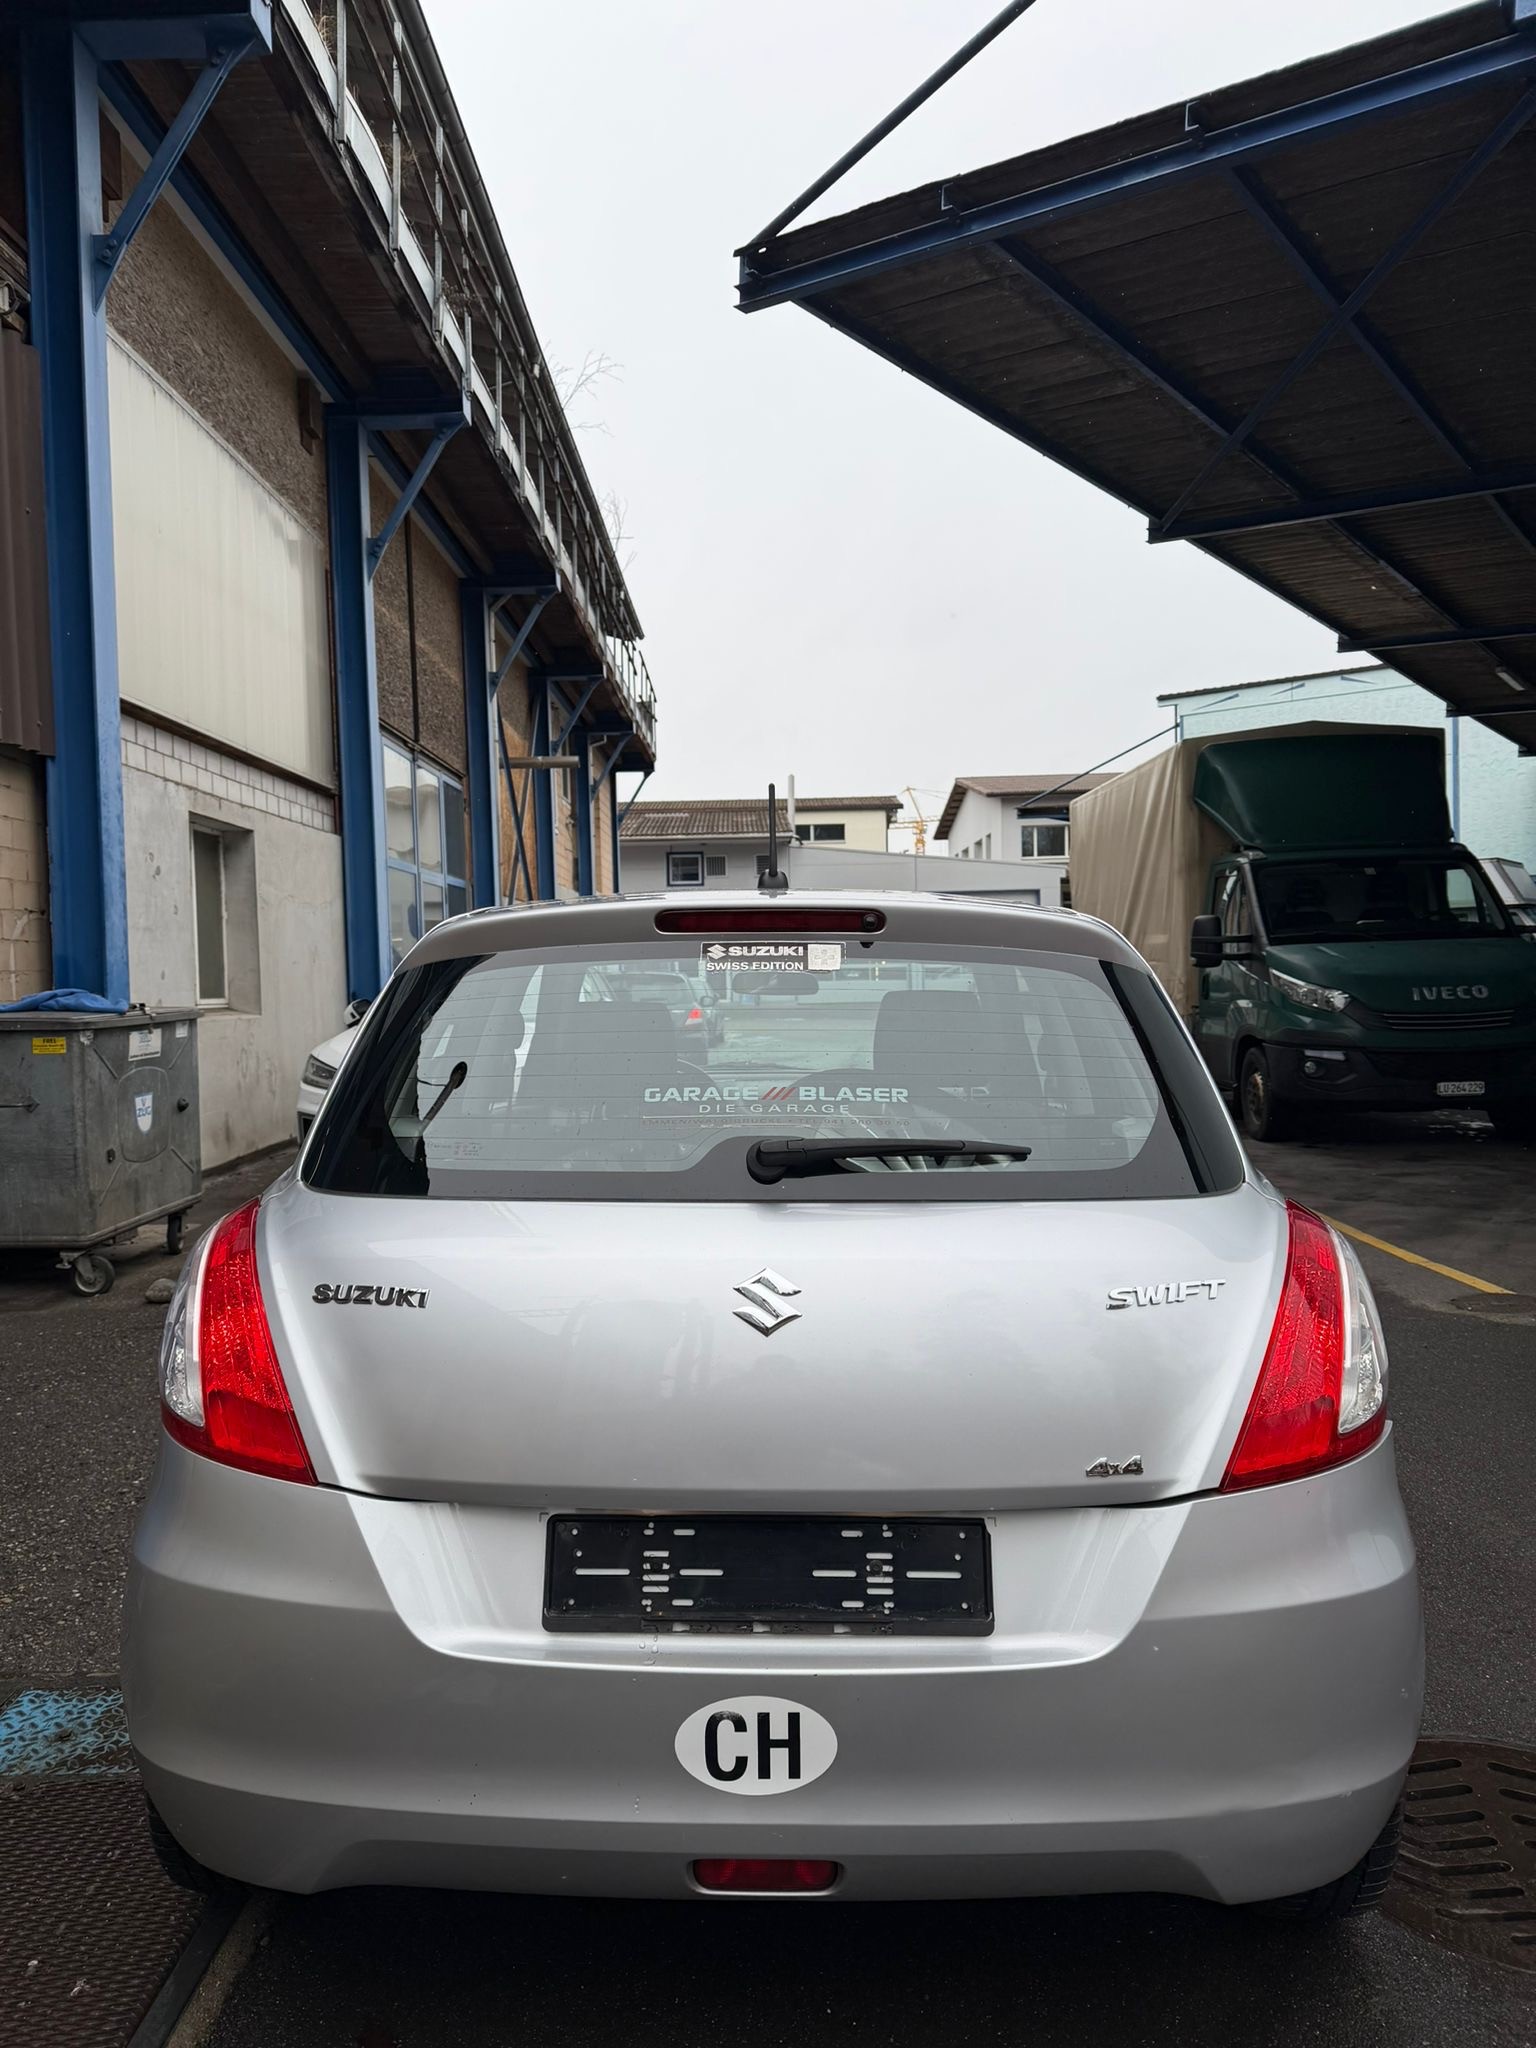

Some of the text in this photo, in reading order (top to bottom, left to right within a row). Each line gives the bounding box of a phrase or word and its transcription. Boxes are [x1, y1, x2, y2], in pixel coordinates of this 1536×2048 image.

[728, 946, 804, 957] SUZUKI
[706, 961, 804, 971] SWISS EDITION
[1412, 985, 1488, 1000] IVECO
[644, 1086, 909, 1103] GARAGE BLASER
[699, 1104, 850, 1115] DIE GARAGE
[312, 1283, 429, 1308] SUZUKI
[1106, 1279, 1226, 1310] SWIFT
[1086, 1455, 1144, 1477] 4x4
[704, 1710, 801, 1782] CH
